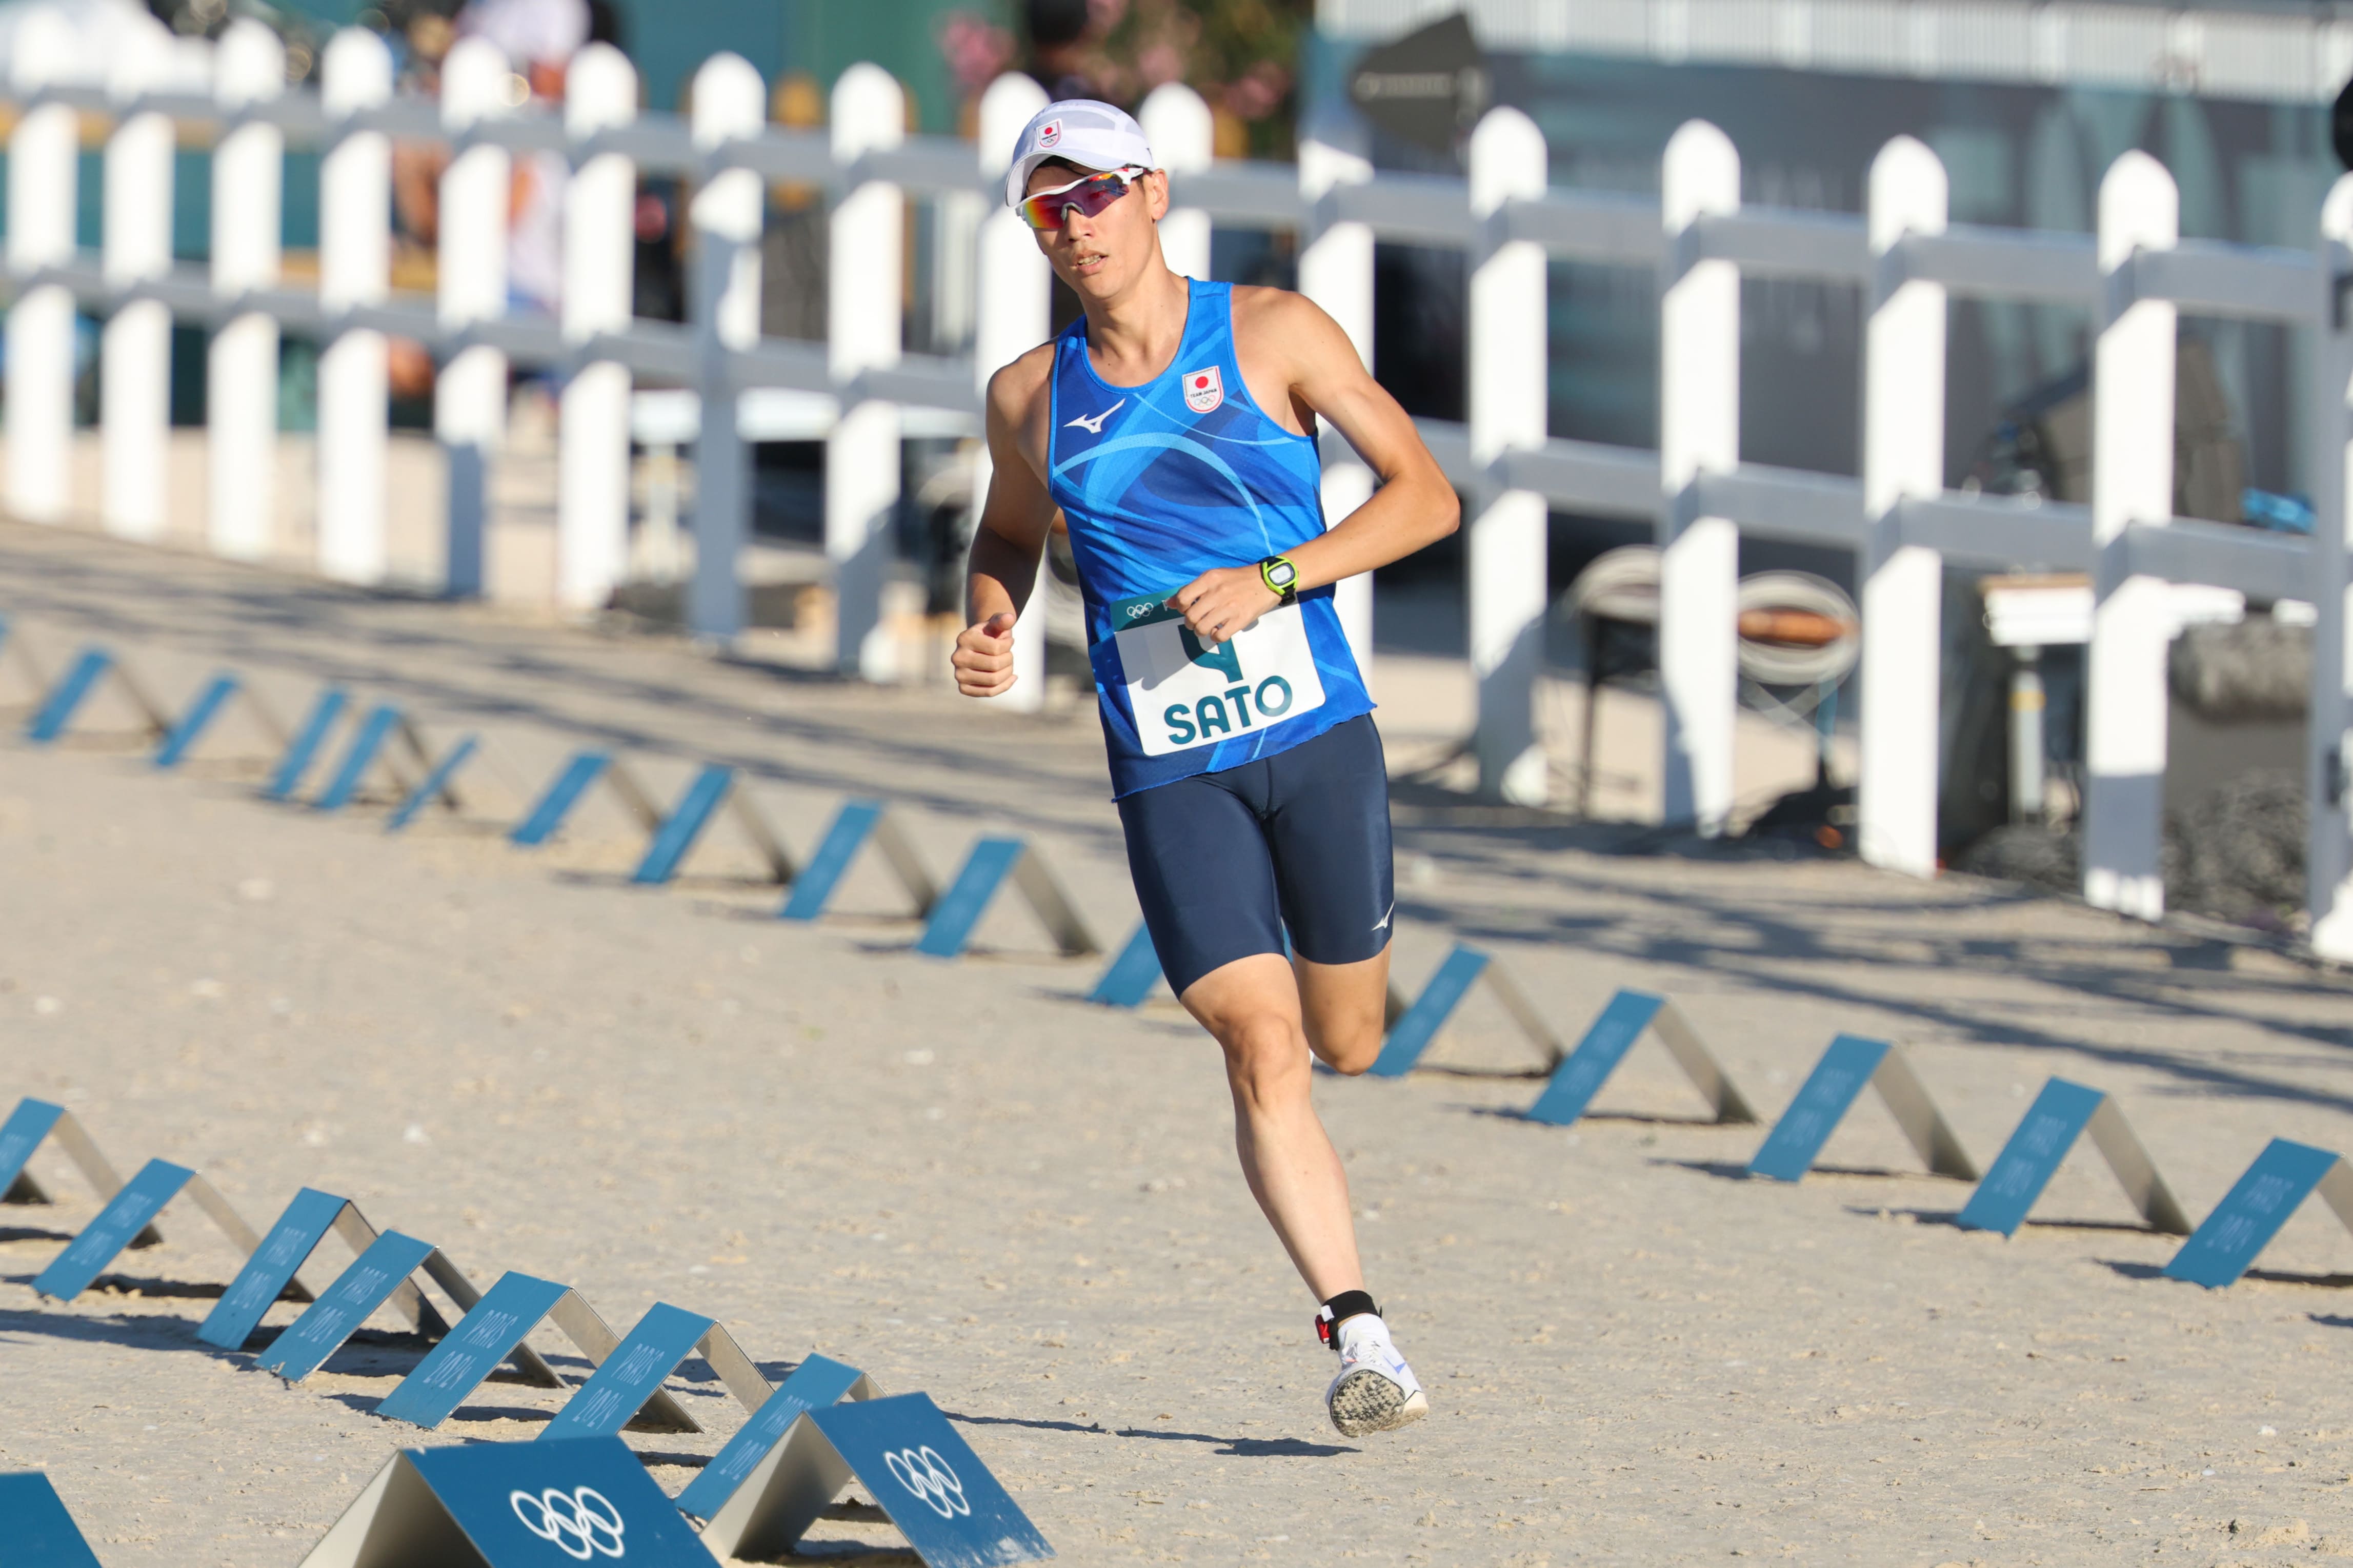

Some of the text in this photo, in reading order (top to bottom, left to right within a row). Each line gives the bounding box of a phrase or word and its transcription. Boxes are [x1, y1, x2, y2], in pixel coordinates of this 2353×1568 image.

[1164, 675, 1293, 745] SATO
[462, 1309, 519, 1349] PARIS
[423, 1351, 477, 1390] 2024
[611, 1343, 665, 1386] PARIS
[572, 1387, 624, 1430] 2024
[719, 1439, 767, 1481] 202
